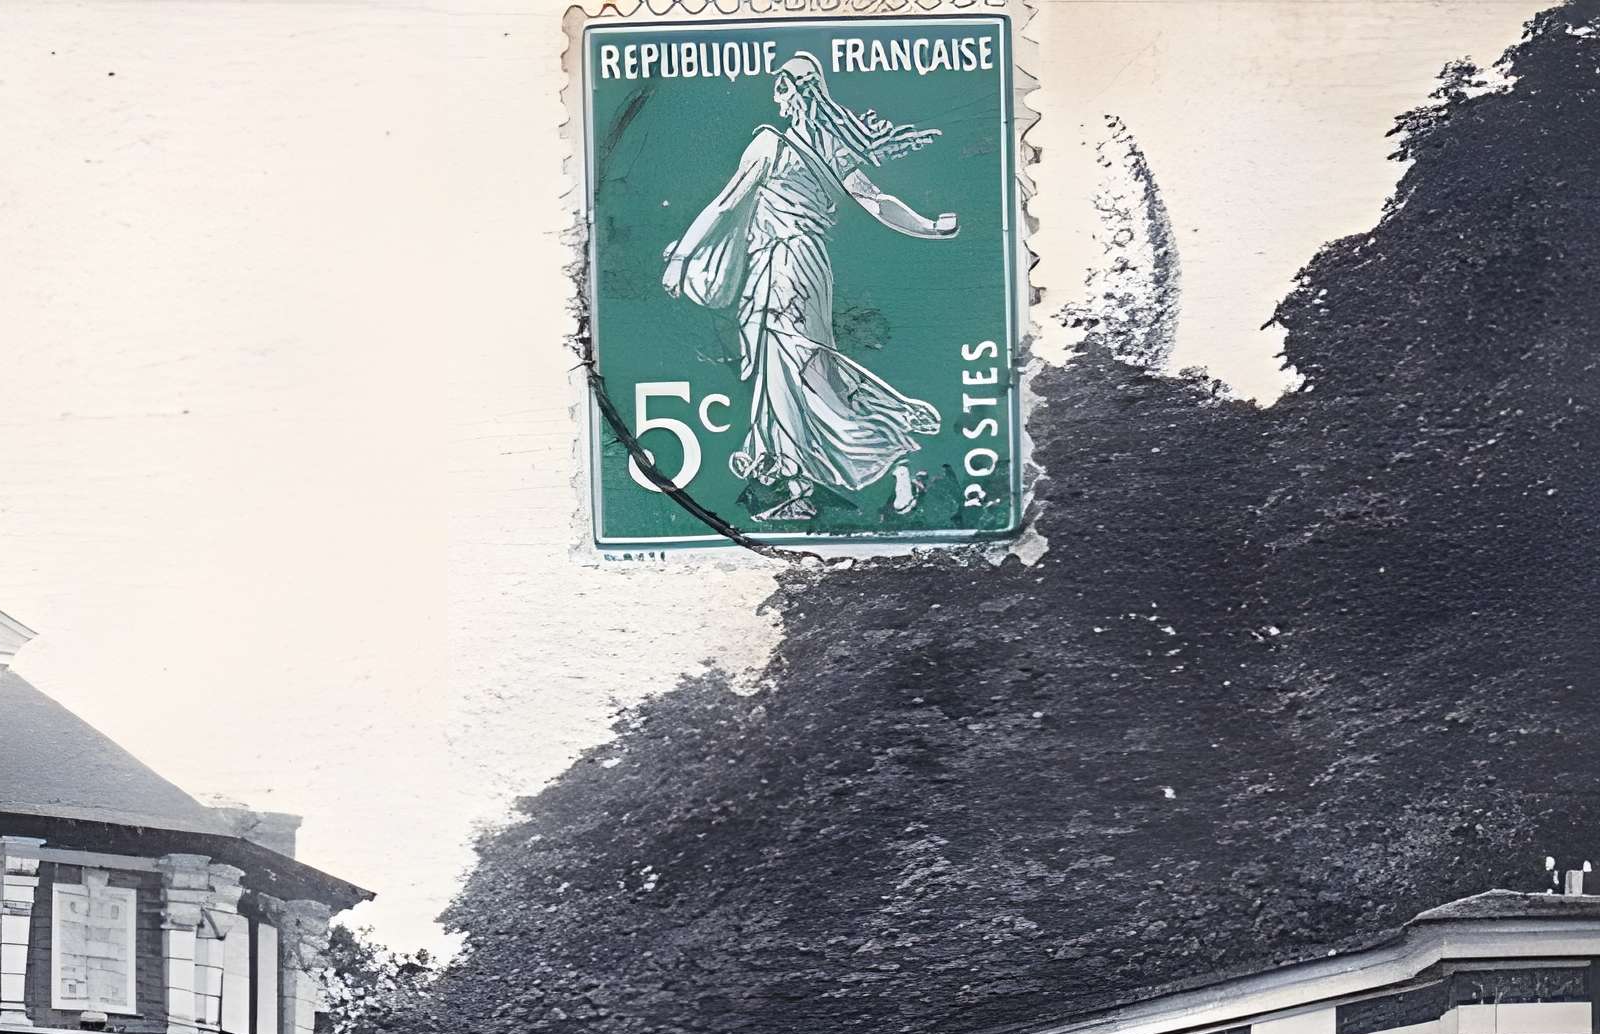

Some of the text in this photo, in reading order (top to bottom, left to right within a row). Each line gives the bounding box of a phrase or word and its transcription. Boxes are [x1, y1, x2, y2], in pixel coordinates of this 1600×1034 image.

[600, 36, 994, 83] REPUBLIQUE FRANÇAISE
[960, 340, 999, 508] POSTES
